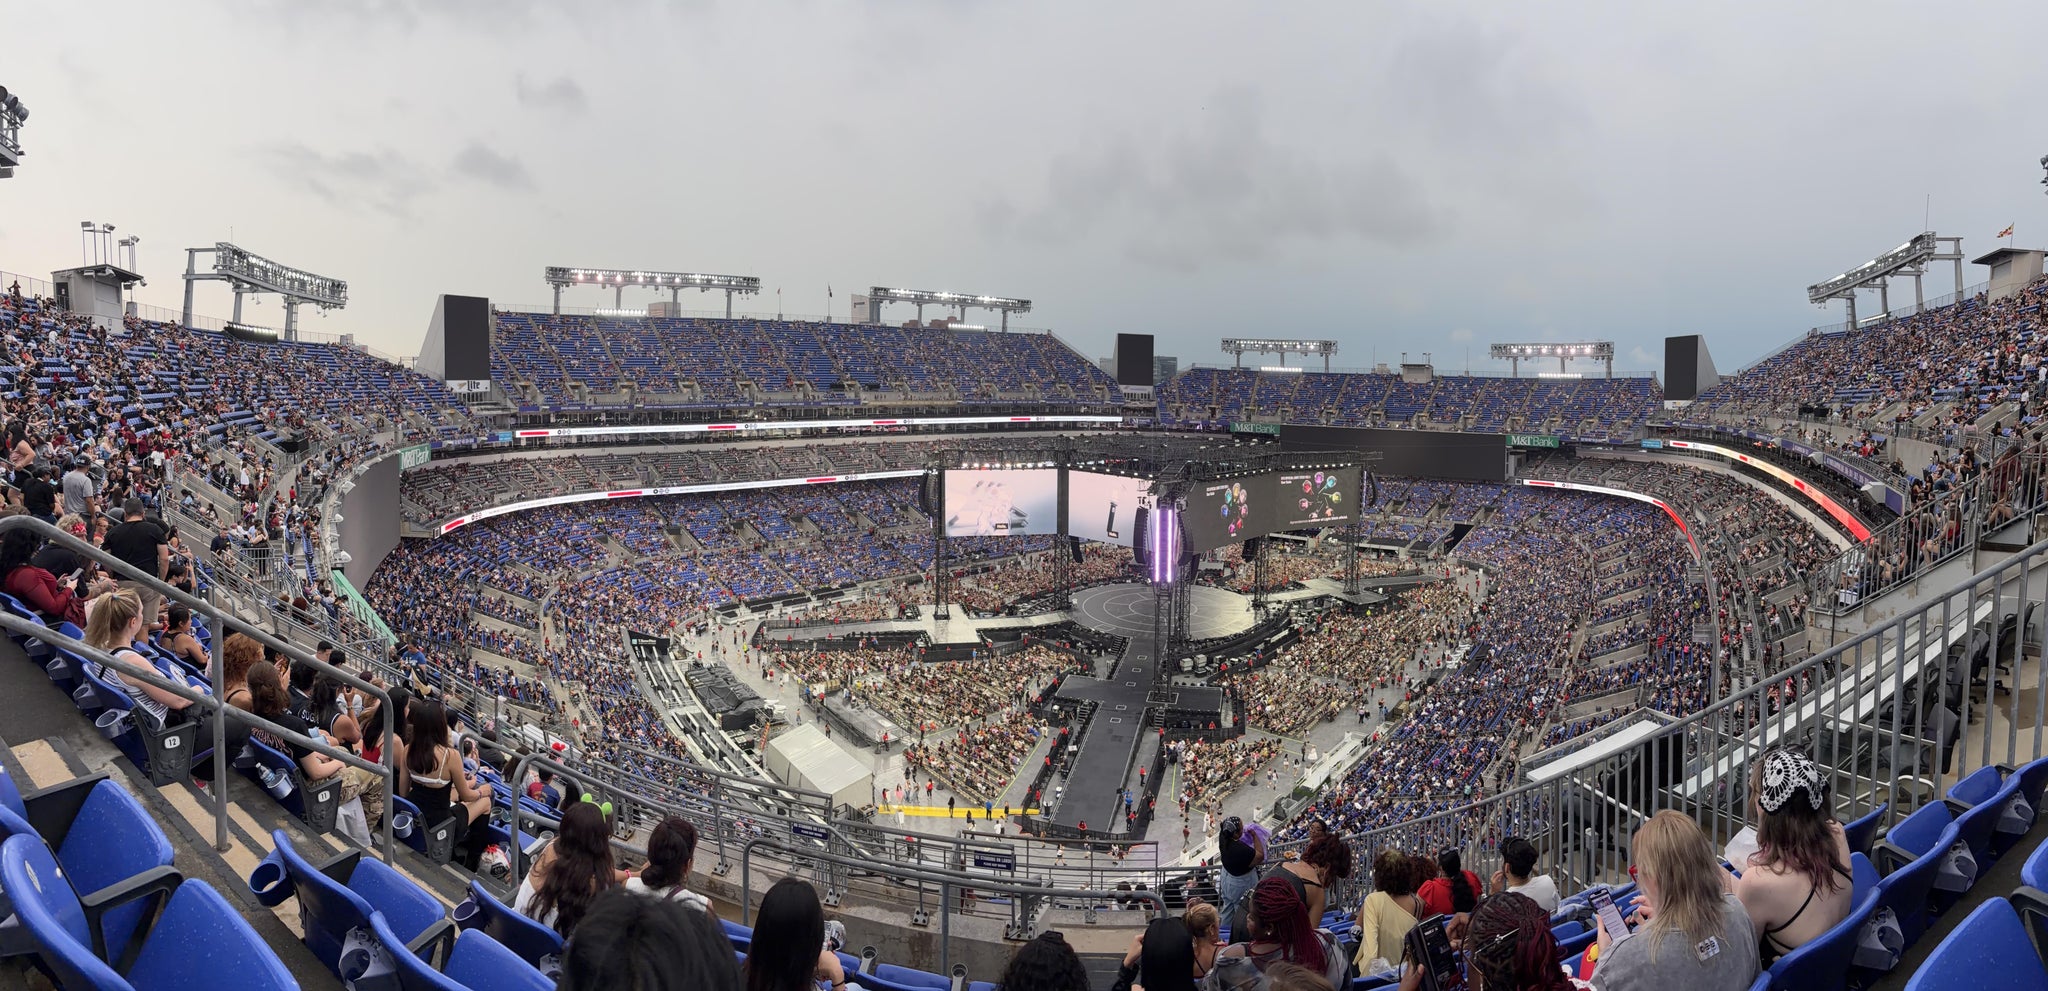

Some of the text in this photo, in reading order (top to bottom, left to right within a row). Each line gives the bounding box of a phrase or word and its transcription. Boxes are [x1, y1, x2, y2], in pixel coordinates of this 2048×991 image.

[468, 380, 480, 392] Lite
[1234, 422, 1276, 434] M&T Bank
[1511, 436, 1554, 447] M&T Bank
[168, 738, 176, 746] 12
